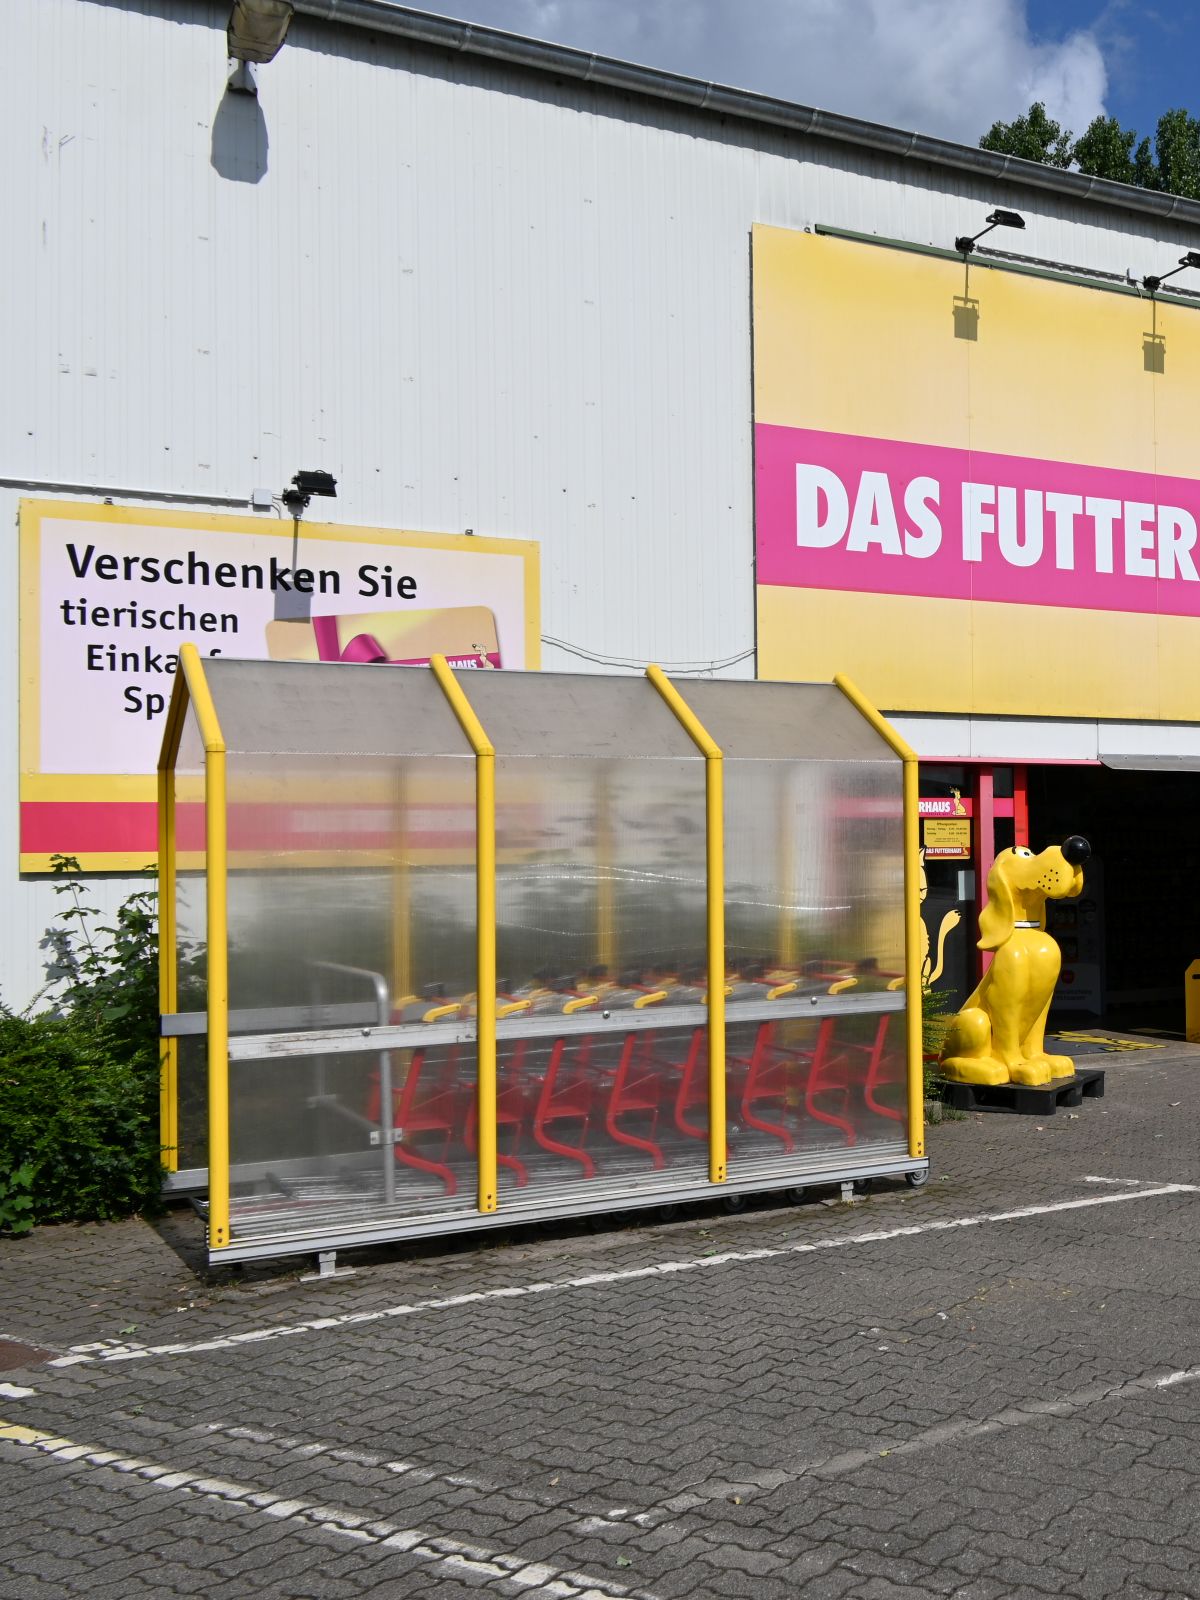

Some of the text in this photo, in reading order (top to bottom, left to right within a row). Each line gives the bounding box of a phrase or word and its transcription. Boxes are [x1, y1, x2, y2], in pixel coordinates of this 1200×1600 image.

[795, 462, 942, 558] DAS
[65, 543, 418, 600] Verschenken Sie
[60, 597, 239, 633] tierischen
[918, 801, 951, 813] RHAUS
